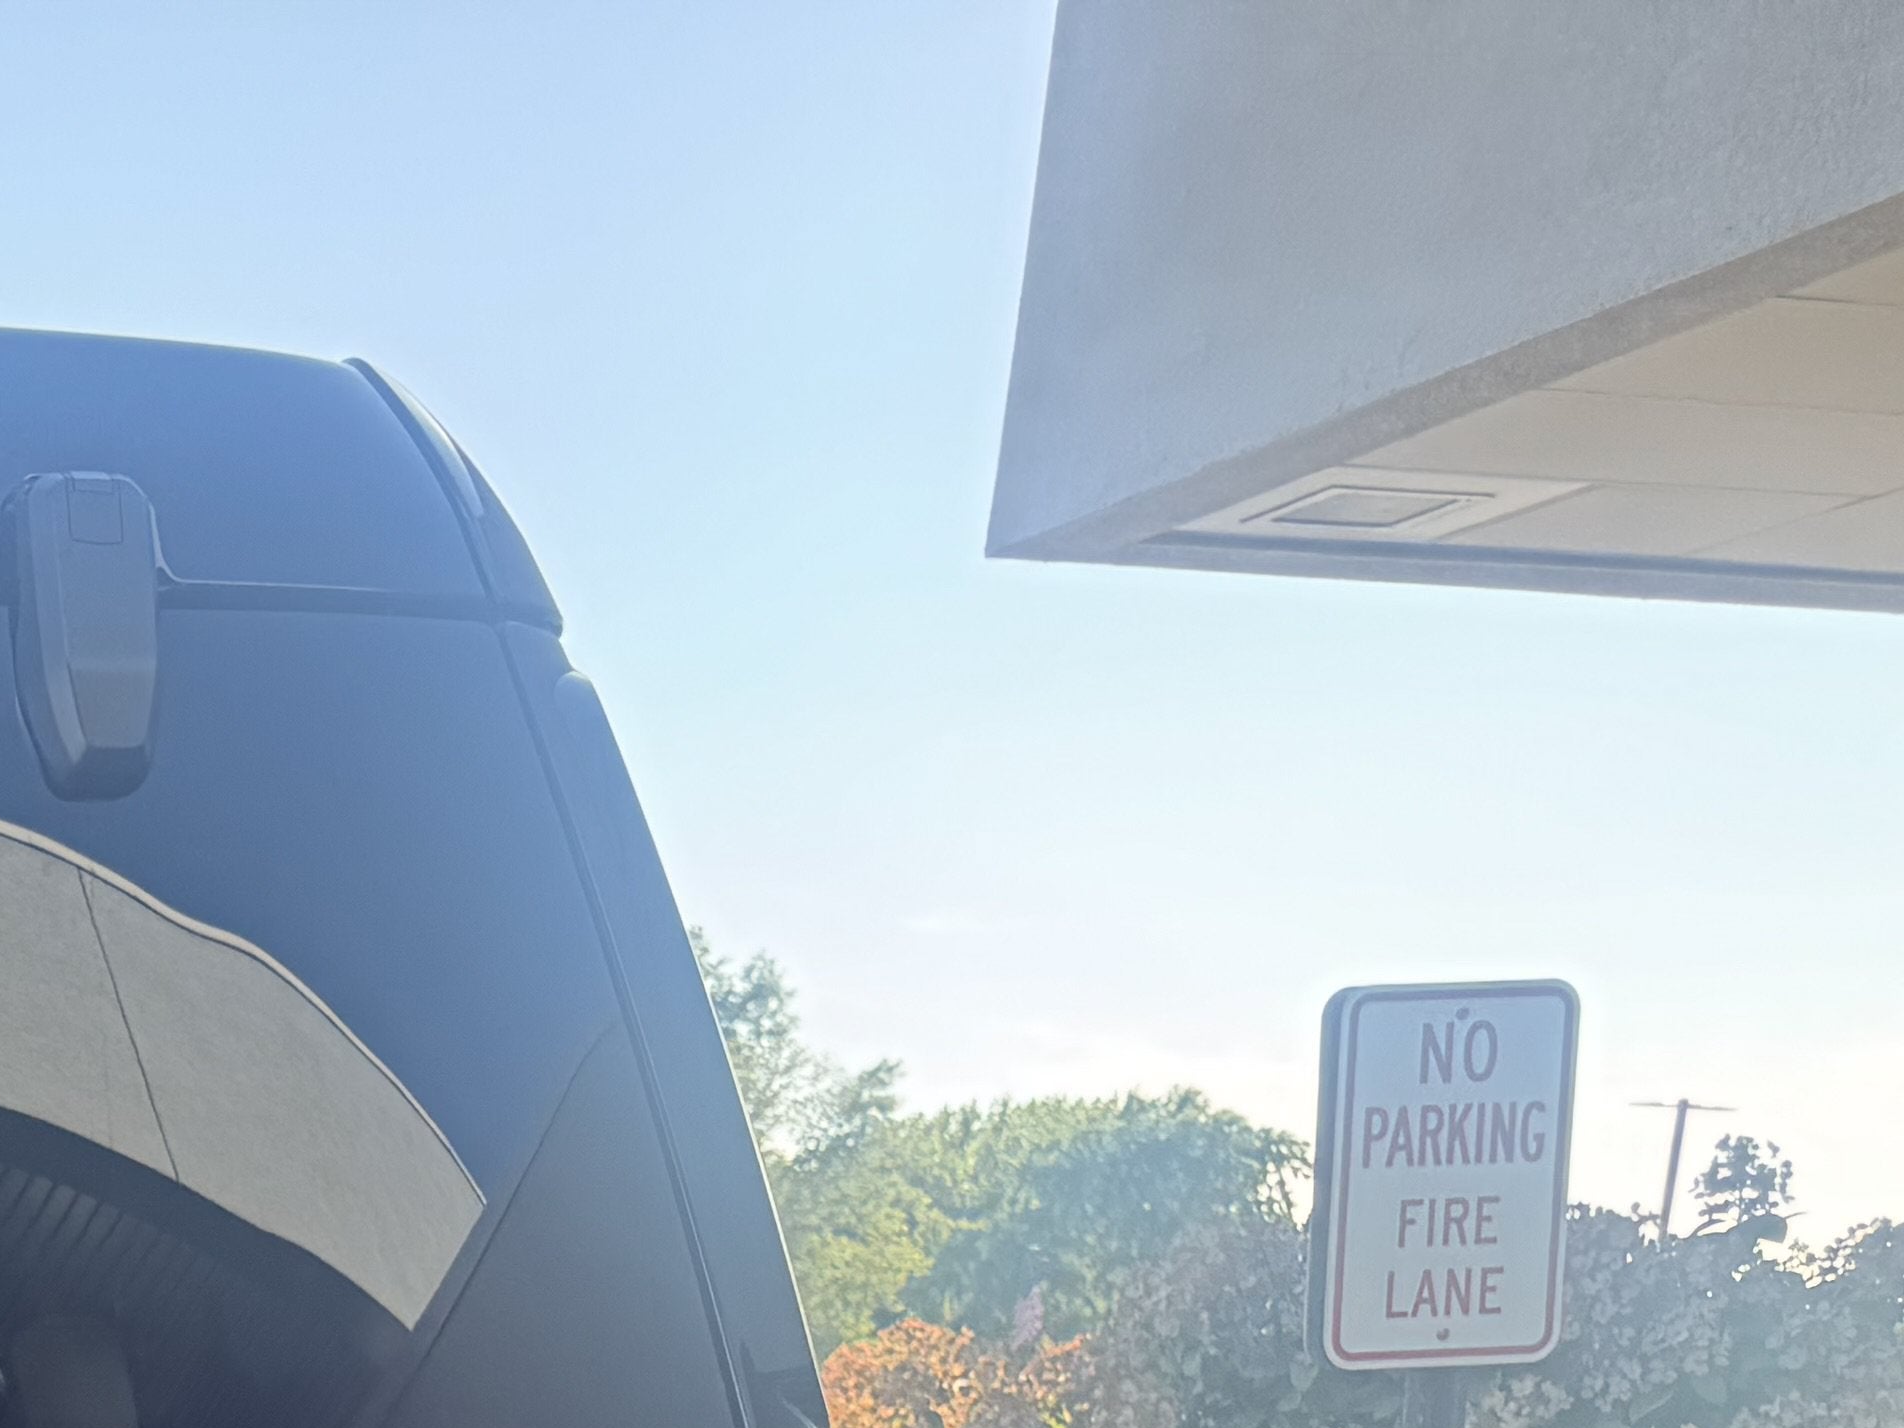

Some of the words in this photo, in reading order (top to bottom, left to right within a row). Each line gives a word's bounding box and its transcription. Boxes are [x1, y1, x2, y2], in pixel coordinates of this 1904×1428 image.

[1418, 1019, 1499, 1085] NO
[1361, 1100, 1546, 1169] PARKING
[1397, 1196, 1502, 1248] FIRE
[1385, 1266, 1504, 1319] LANE
